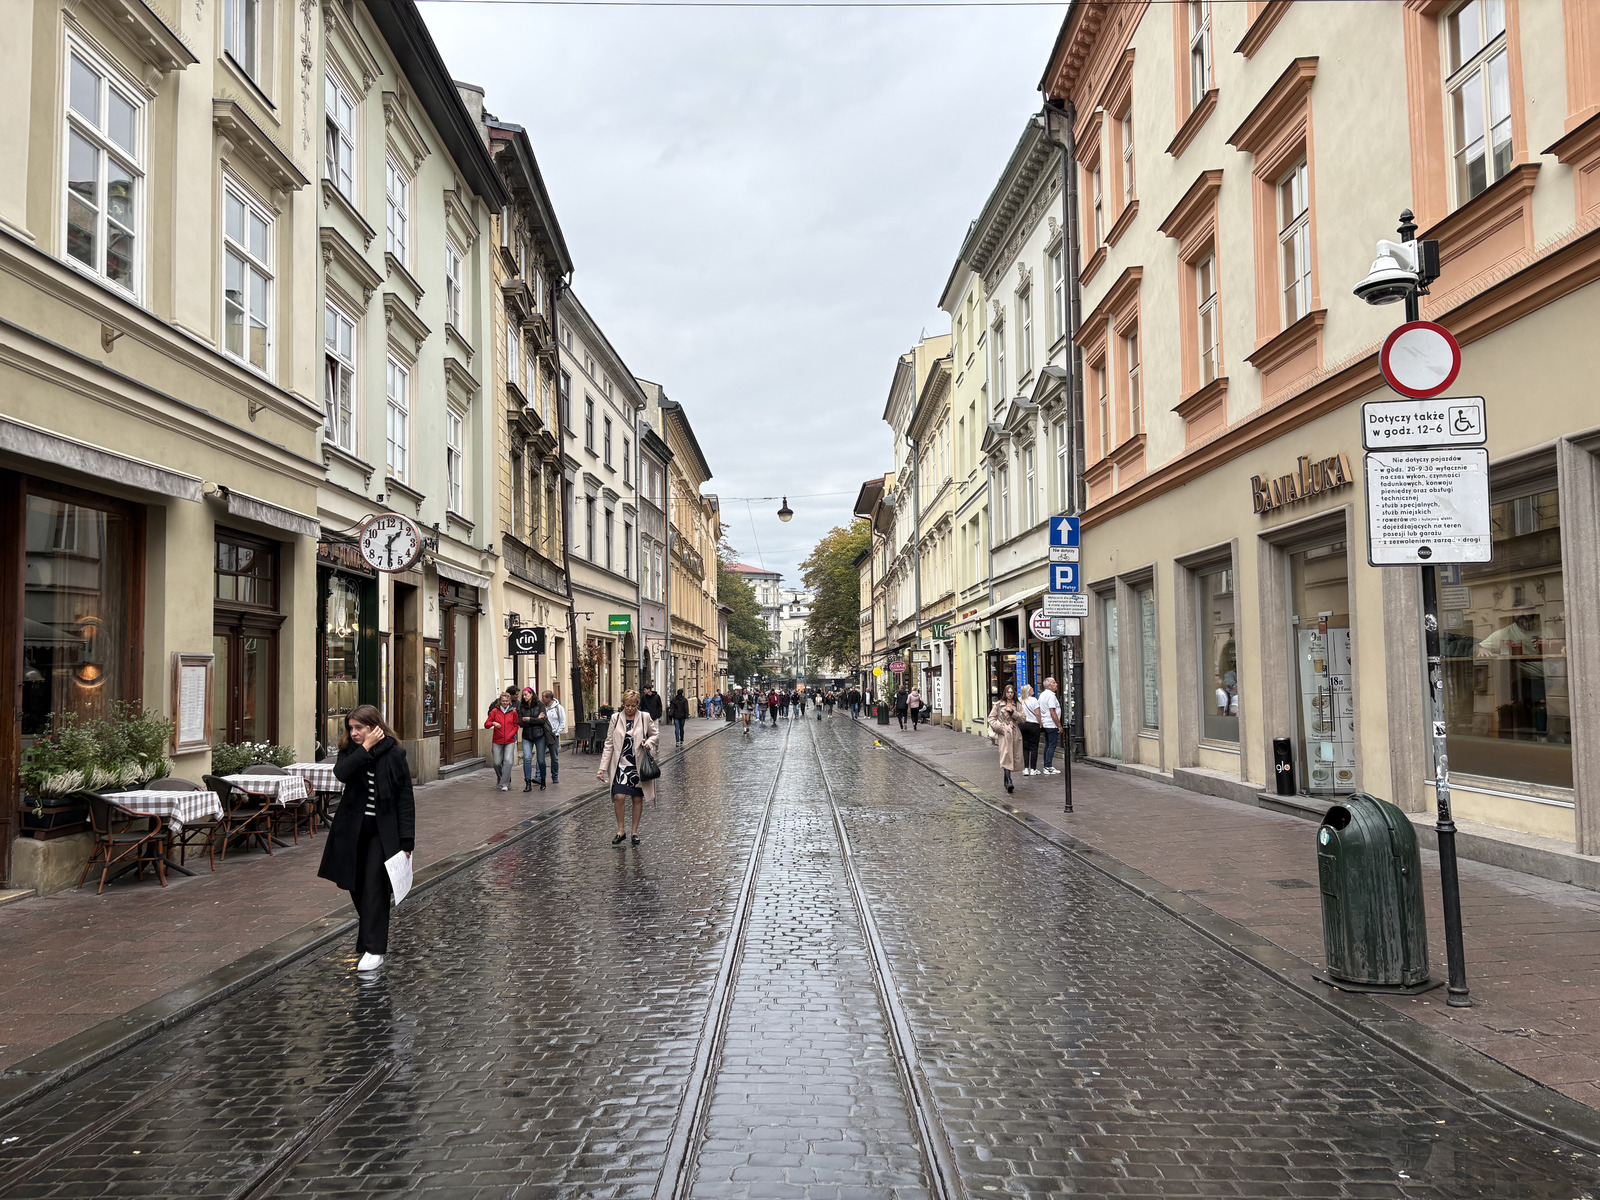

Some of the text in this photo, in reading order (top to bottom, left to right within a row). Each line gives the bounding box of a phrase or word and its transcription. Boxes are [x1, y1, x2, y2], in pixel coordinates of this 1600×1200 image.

[1369, 411, 1445, 425] Dotyczy także
[1373, 424, 1443, 438] w godz. 12-6
[1431, 456, 1462, 464] pojazdów
[1435, 465, 1468, 473] wyłącznie
[1429, 486, 1454, 494] obsługi
[1400, 508, 1432, 516] miejskich
[377, 520, 385, 530] 11
[387, 518, 396, 528] 12
[399, 520, 404, 530] 1
[369, 529, 378, 538] 10
[405, 527, 412, 537] 2
[365, 538, 371, 548] 9
[410, 538, 416, 548] 3
[369, 549, 375, 559] 8
[405, 548, 411, 558] 4
[377, 556, 383, 566] 7
[397, 555, 404, 566] 5
[1056, 566, 1073, 589] P
[519, 634, 535, 644] rin
[1275, 760, 1291, 774] glo
